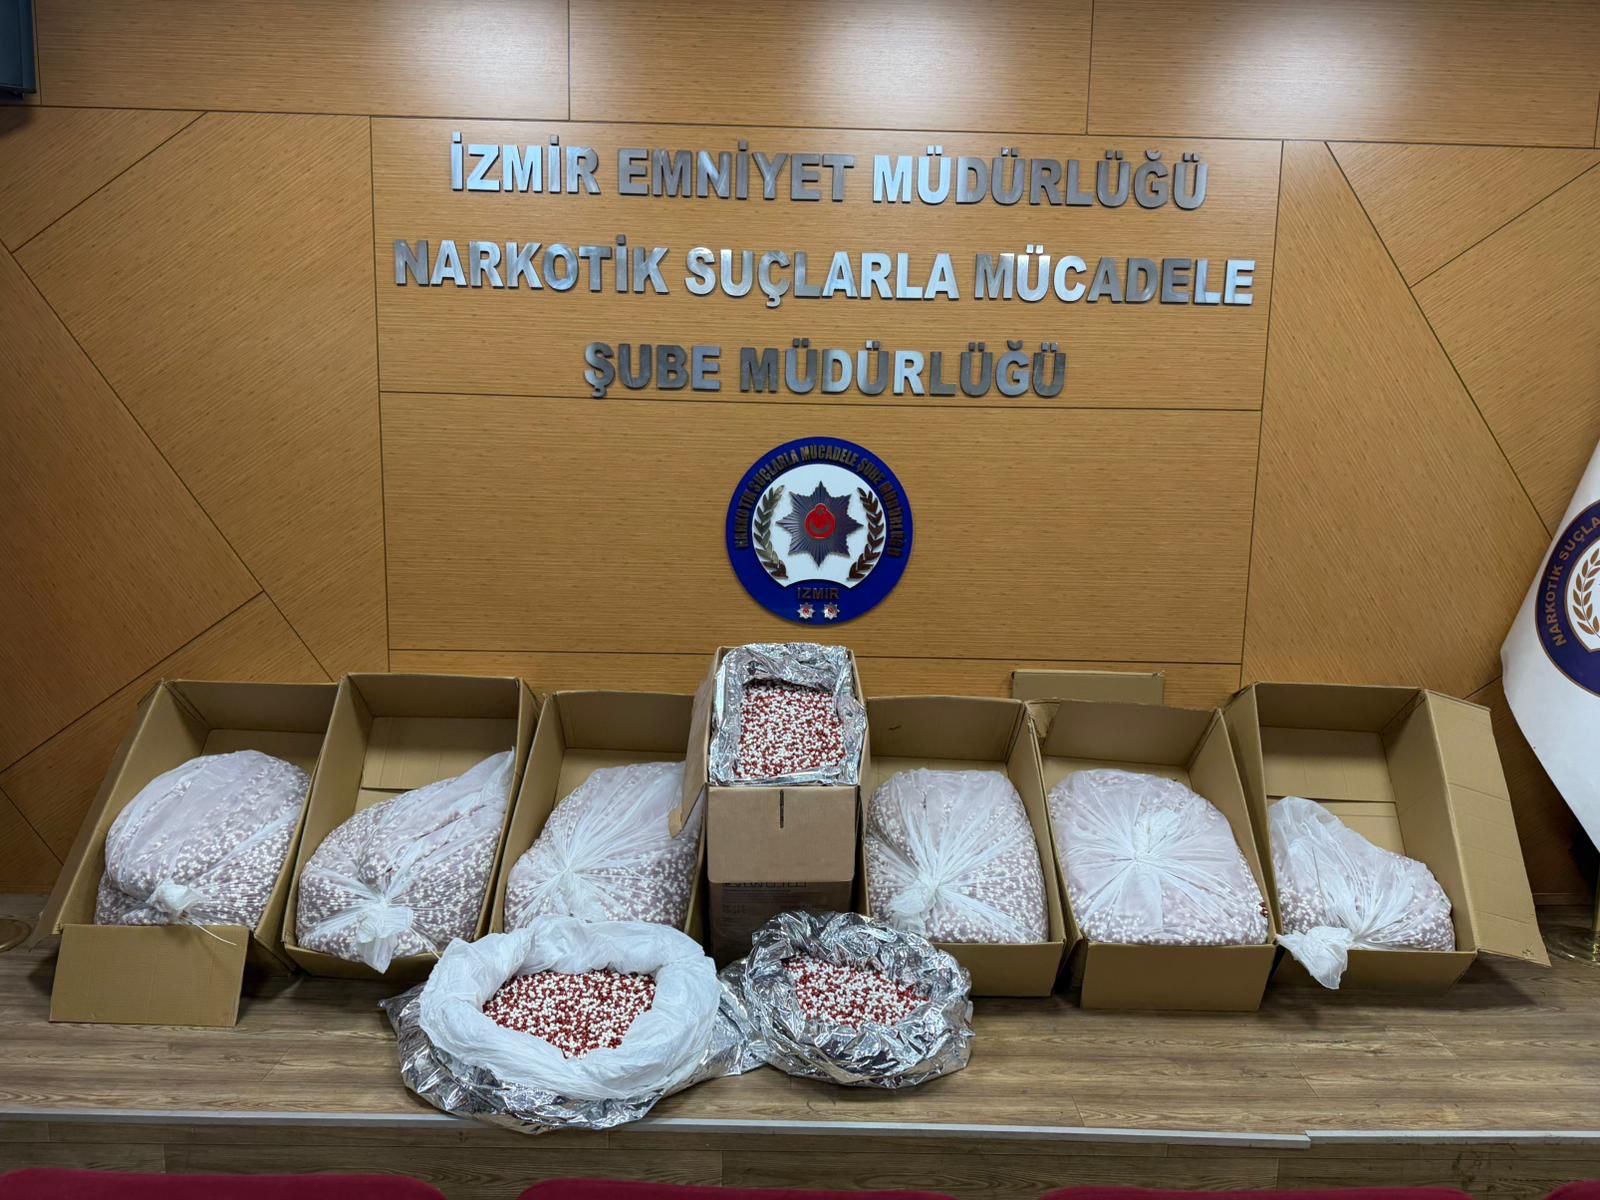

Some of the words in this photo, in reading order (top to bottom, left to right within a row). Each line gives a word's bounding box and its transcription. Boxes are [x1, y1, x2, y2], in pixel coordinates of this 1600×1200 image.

[451, 131, 600, 194] İZMİR
[618, 139, 856, 202] EMNİYET
[872, 145, 1209, 210] MÜDÜRLÜĞÜ
[394, 234, 670, 294] NARKOTİK
[685, 246, 960, 308] SUÇLARLA
[974, 244, 1256, 305] MÜCADELE
[584, 341, 721, 399] ŞUBE
[739, 337, 1067, 398] MÜDÜRLÜĞÜ
[1545, 565, 1566, 645] NARKOTİK
